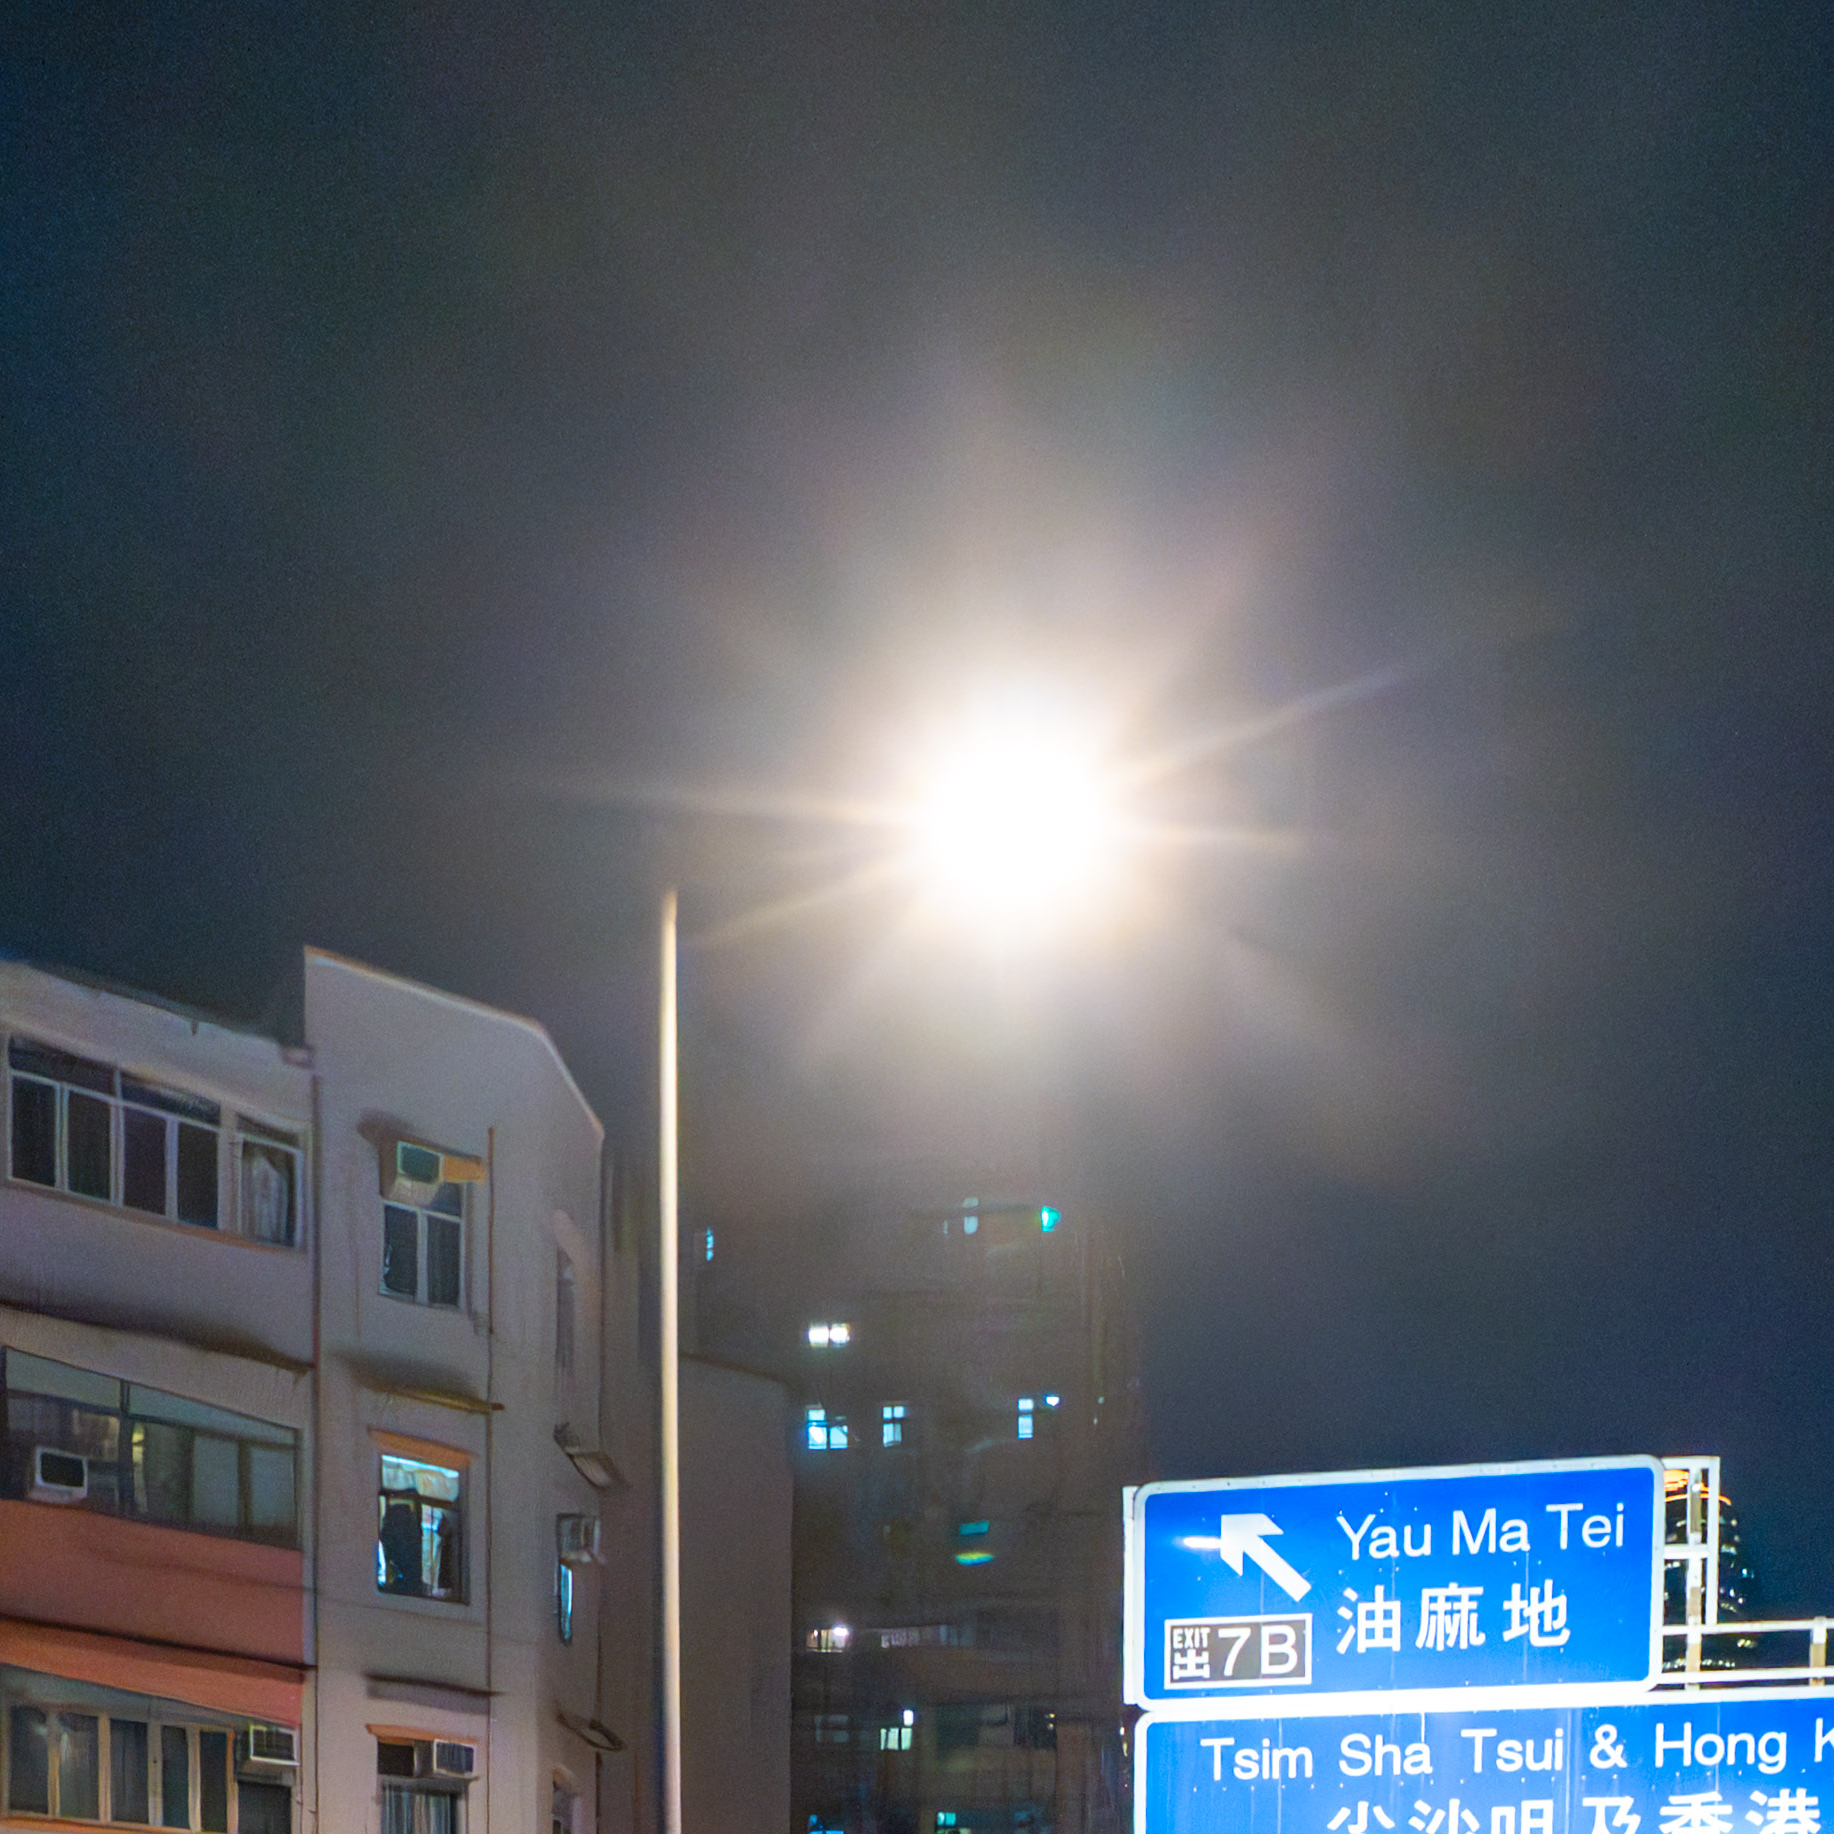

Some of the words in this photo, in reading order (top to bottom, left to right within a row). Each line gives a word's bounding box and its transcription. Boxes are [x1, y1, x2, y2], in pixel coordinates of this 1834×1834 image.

[1337, 1514, 1433, 1562] Yau
[1451, 1508, 1530, 1556] Ma
[1546, 1501, 1625, 1551] Tei
[1172, 1627, 1210, 1649] EXIT
[1335, 1579, 1571, 1655] 油麻地
[1172, 1649, 1210, 1680] 出
[1218, 1624, 1299, 1677] 7B
[1201, 1736, 1314, 1781] Tsim
[1339, 1732, 1433, 1776] Sha
[1461, 1726, 1565, 1772] Tsui
[1590, 1725, 1627, 1769] &
[1654, 1721, 1787, 1774] Hong
